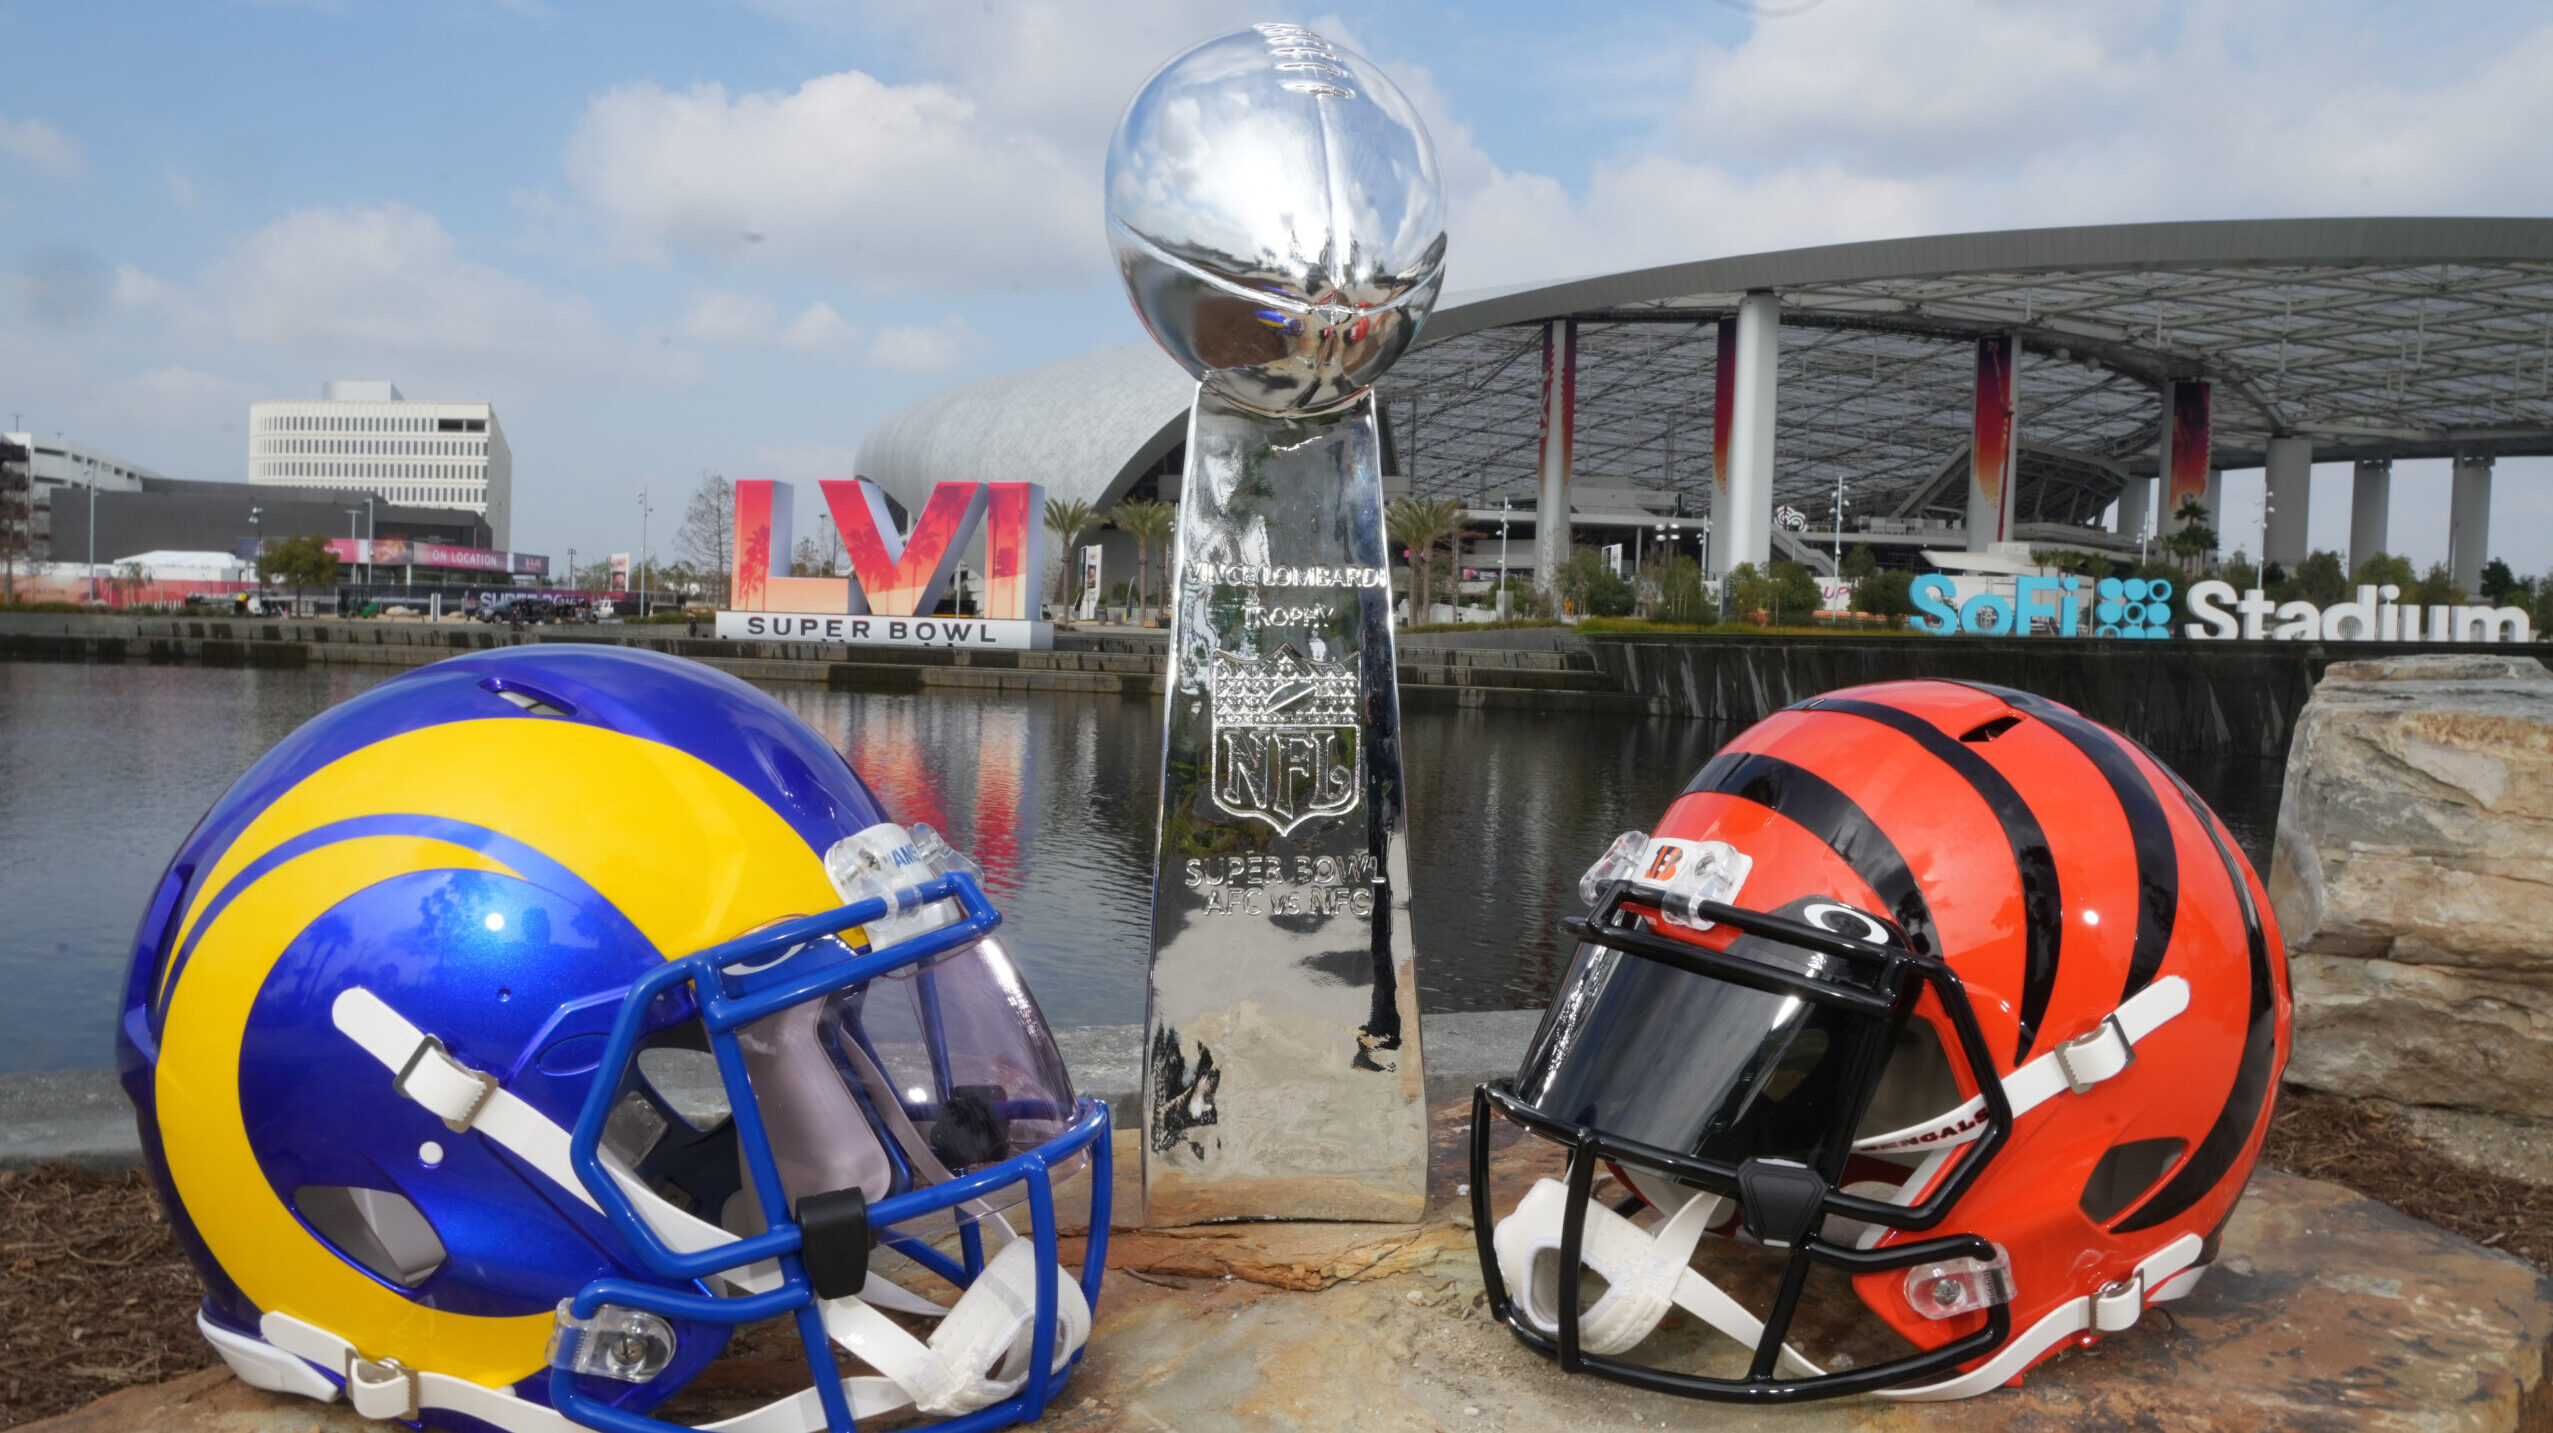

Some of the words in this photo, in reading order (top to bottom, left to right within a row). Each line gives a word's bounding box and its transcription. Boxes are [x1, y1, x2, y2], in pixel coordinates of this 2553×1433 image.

[432, 549, 447, 561] ON
[451, 551, 497, 567] LOCATION
[731, 479, 1042, 619] LVI
[1184, 561, 1257, 587] VINCE
[1263, 565, 1388, 588] LOMBARDI
[1242, 604, 1335, 628] TROPHY
[1909, 574, 2080, 637] SoFi
[2185, 580, 2531, 642] Stadium
[747, 616, 871, 639] SUPER
[889, 621, 997, 644] BOWL
[1223, 729, 1352, 820] NFL
[1184, 856, 1284, 887] SUPER
[1294, 854, 1387, 885] BOWL
[1202, 887, 1263, 916] AFC
[1309, 886, 1371, 916] NFC
